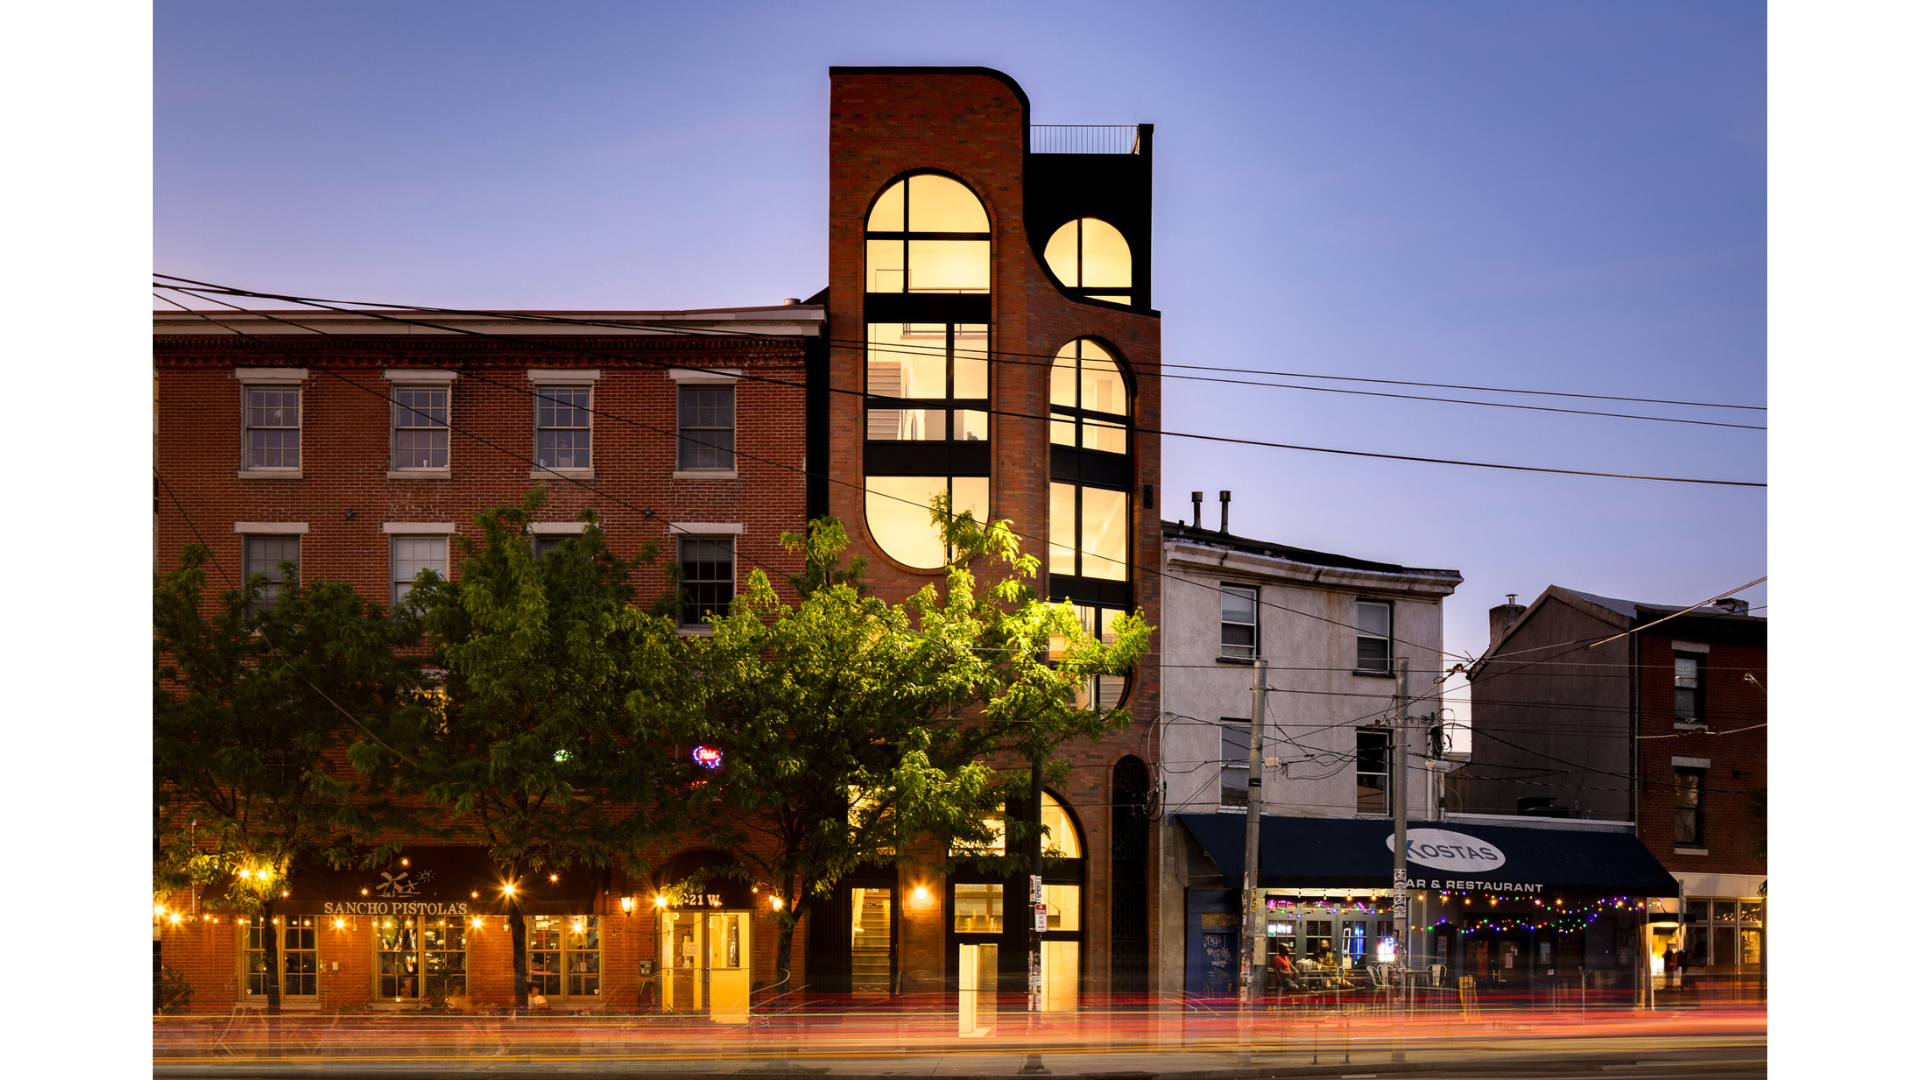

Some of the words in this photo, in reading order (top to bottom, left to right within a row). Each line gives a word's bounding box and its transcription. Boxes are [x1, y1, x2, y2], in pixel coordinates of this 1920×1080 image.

[1404, 878, 1427, 889] AR
[1430, 879, 1441, 889] &
[1445, 880, 1544, 893] RESTAURANT
[324, 902, 388, 915] SANCHO
[391, 902, 468, 915] PISTOLA'S
